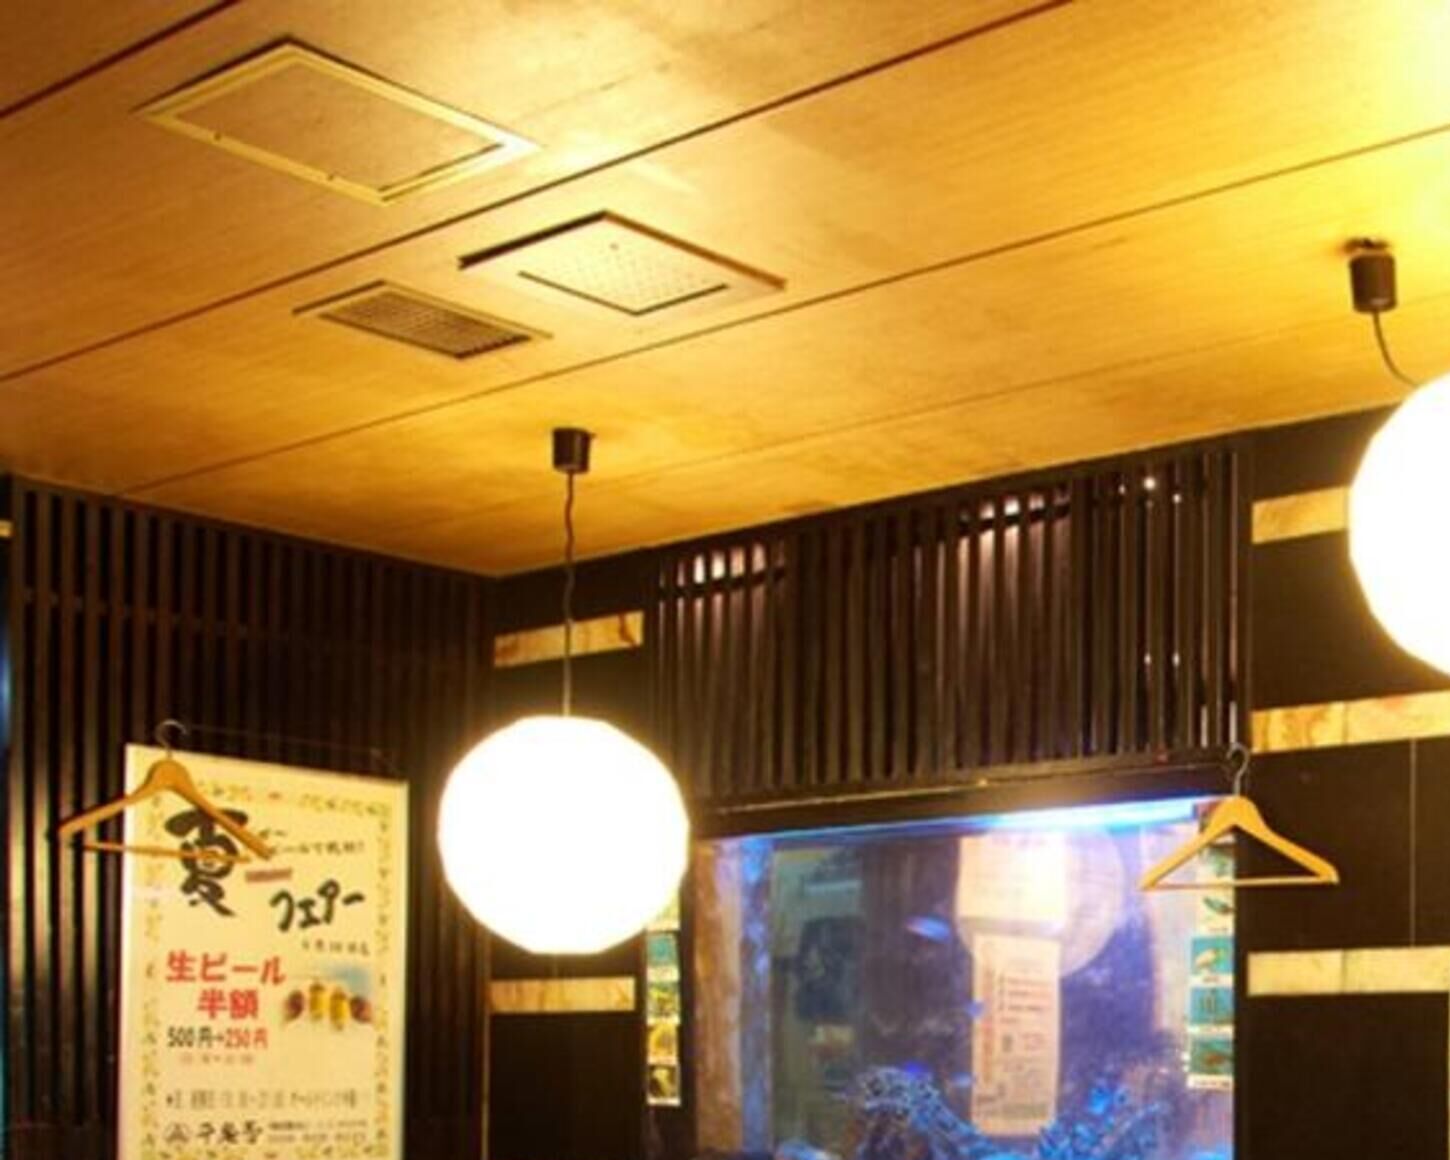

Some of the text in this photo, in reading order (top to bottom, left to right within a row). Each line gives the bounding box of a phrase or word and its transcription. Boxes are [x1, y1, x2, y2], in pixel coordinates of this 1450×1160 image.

[164, 808, 248, 917] 夏
[165, 949, 286, 986] 生ビール
[197, 988, 260, 1020] 半額
